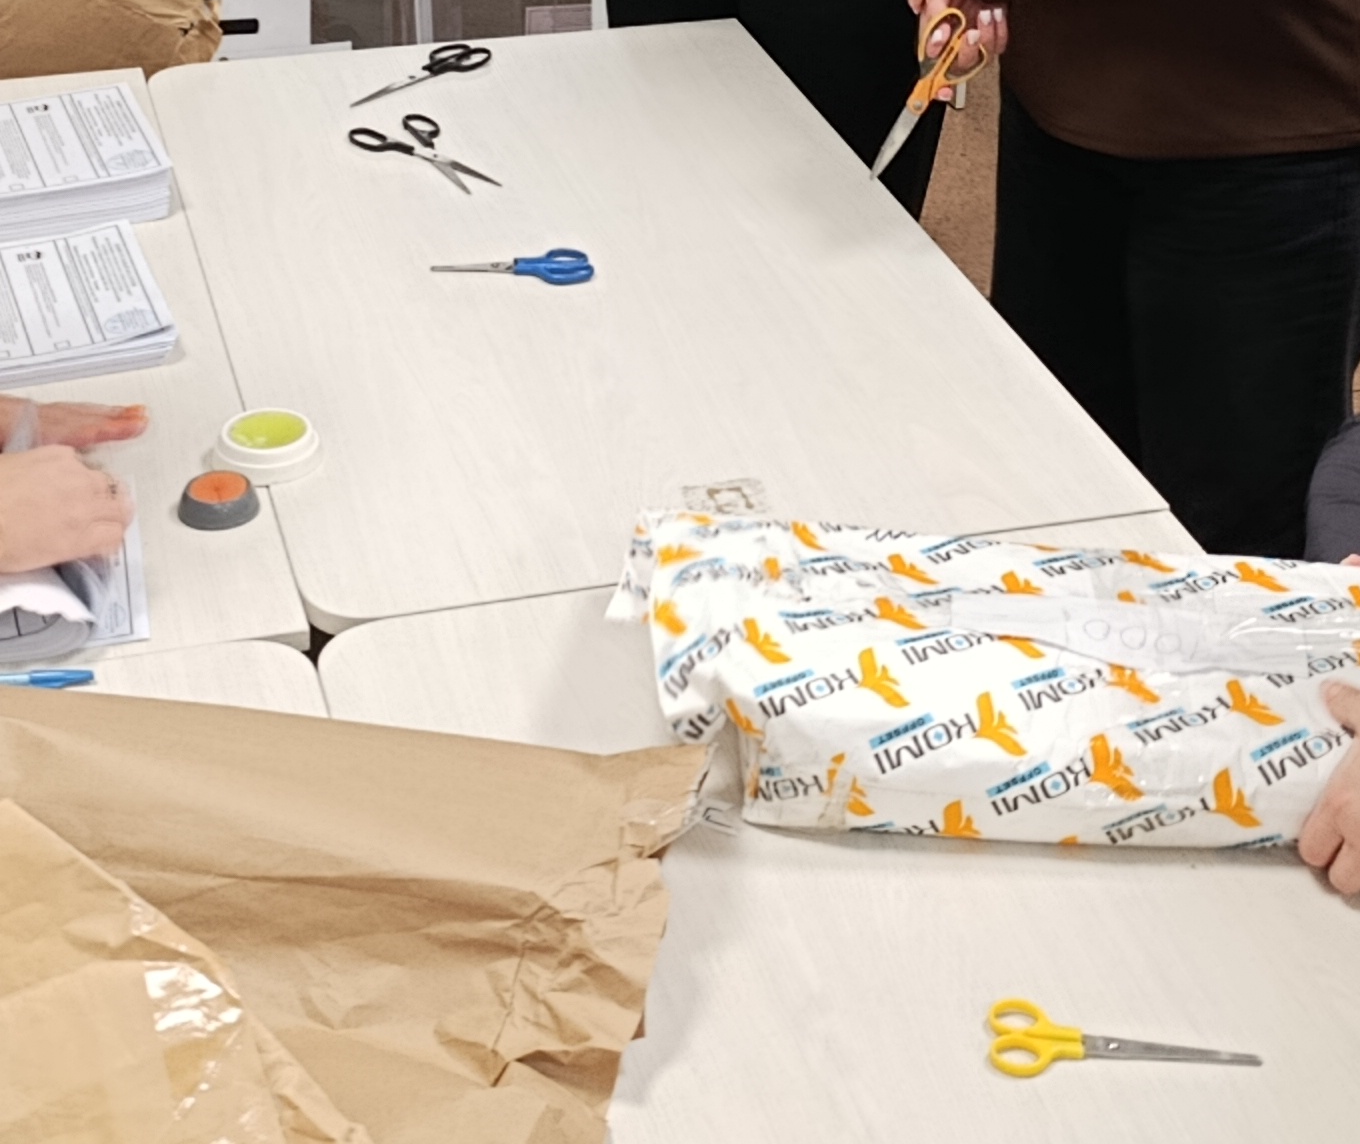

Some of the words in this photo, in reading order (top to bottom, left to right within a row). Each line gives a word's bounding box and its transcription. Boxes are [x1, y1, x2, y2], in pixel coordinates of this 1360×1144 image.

[756, 668, 860, 721] KOMI
[1016, 668, 1104, 712] KOMI
[872, 712, 978, 776] KOMI
[875, 716, 926, 746] OFFSET
[1132, 695, 1231, 747] KOMI
[989, 756, 1091, 817] KOMI
[992, 766, 1042, 796] OFFSET
